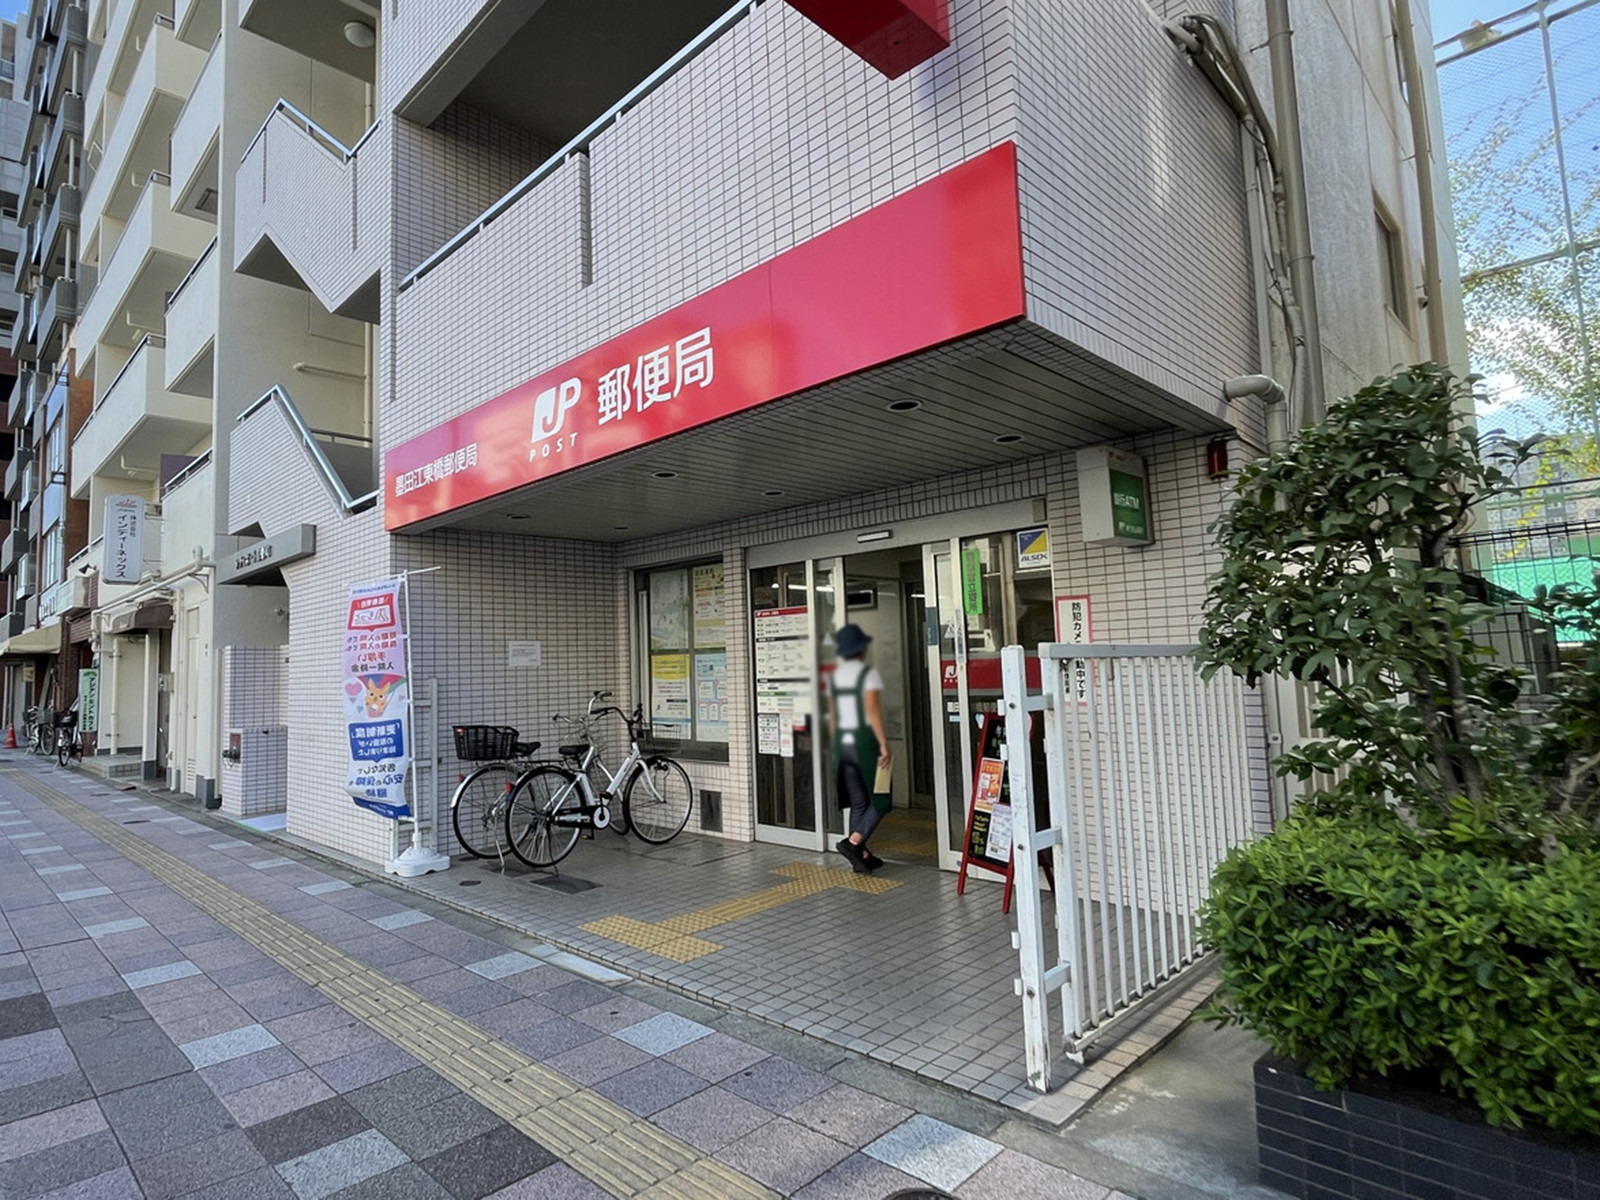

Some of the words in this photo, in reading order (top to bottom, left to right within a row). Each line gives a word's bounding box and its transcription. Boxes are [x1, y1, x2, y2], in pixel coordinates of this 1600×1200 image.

[597, 327, 714, 425] 郵便局
[531, 377, 582, 443] JP
[395, 443, 477, 497] 墨田江東橋郵便局
[529, 432, 578, 462] POST
[1021, 553, 1048, 562] ALSOK
